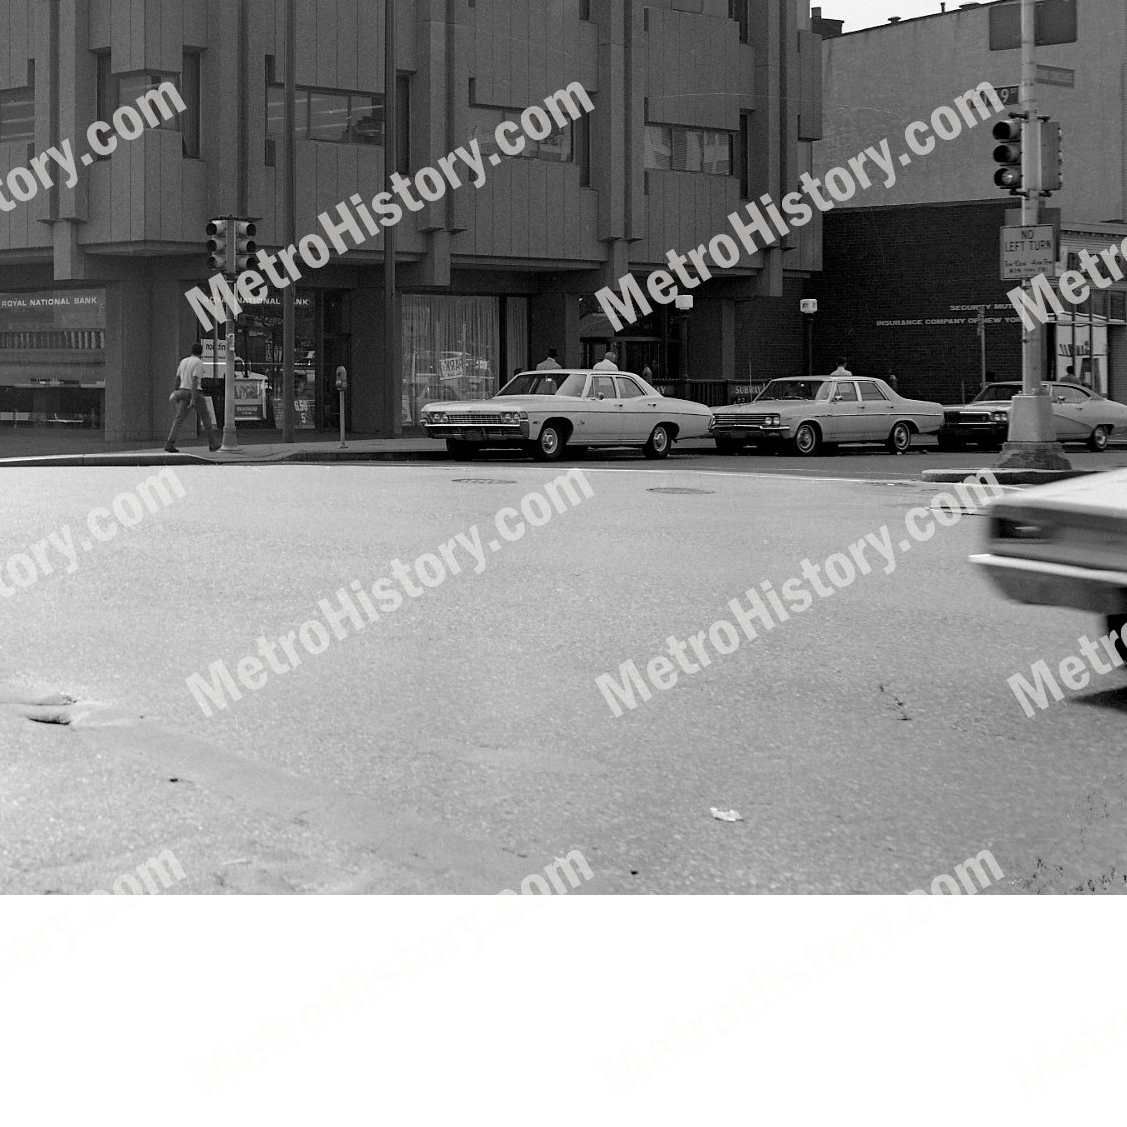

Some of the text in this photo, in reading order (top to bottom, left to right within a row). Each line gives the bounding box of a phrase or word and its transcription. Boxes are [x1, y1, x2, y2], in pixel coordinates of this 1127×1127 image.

[1021, 229, 1034, 240] NO
[1004, 240, 1051, 252] LEFT TURN
[29, 298, 70, 306] NATIONAL
[735, 386, 761, 394] SUBWAY
